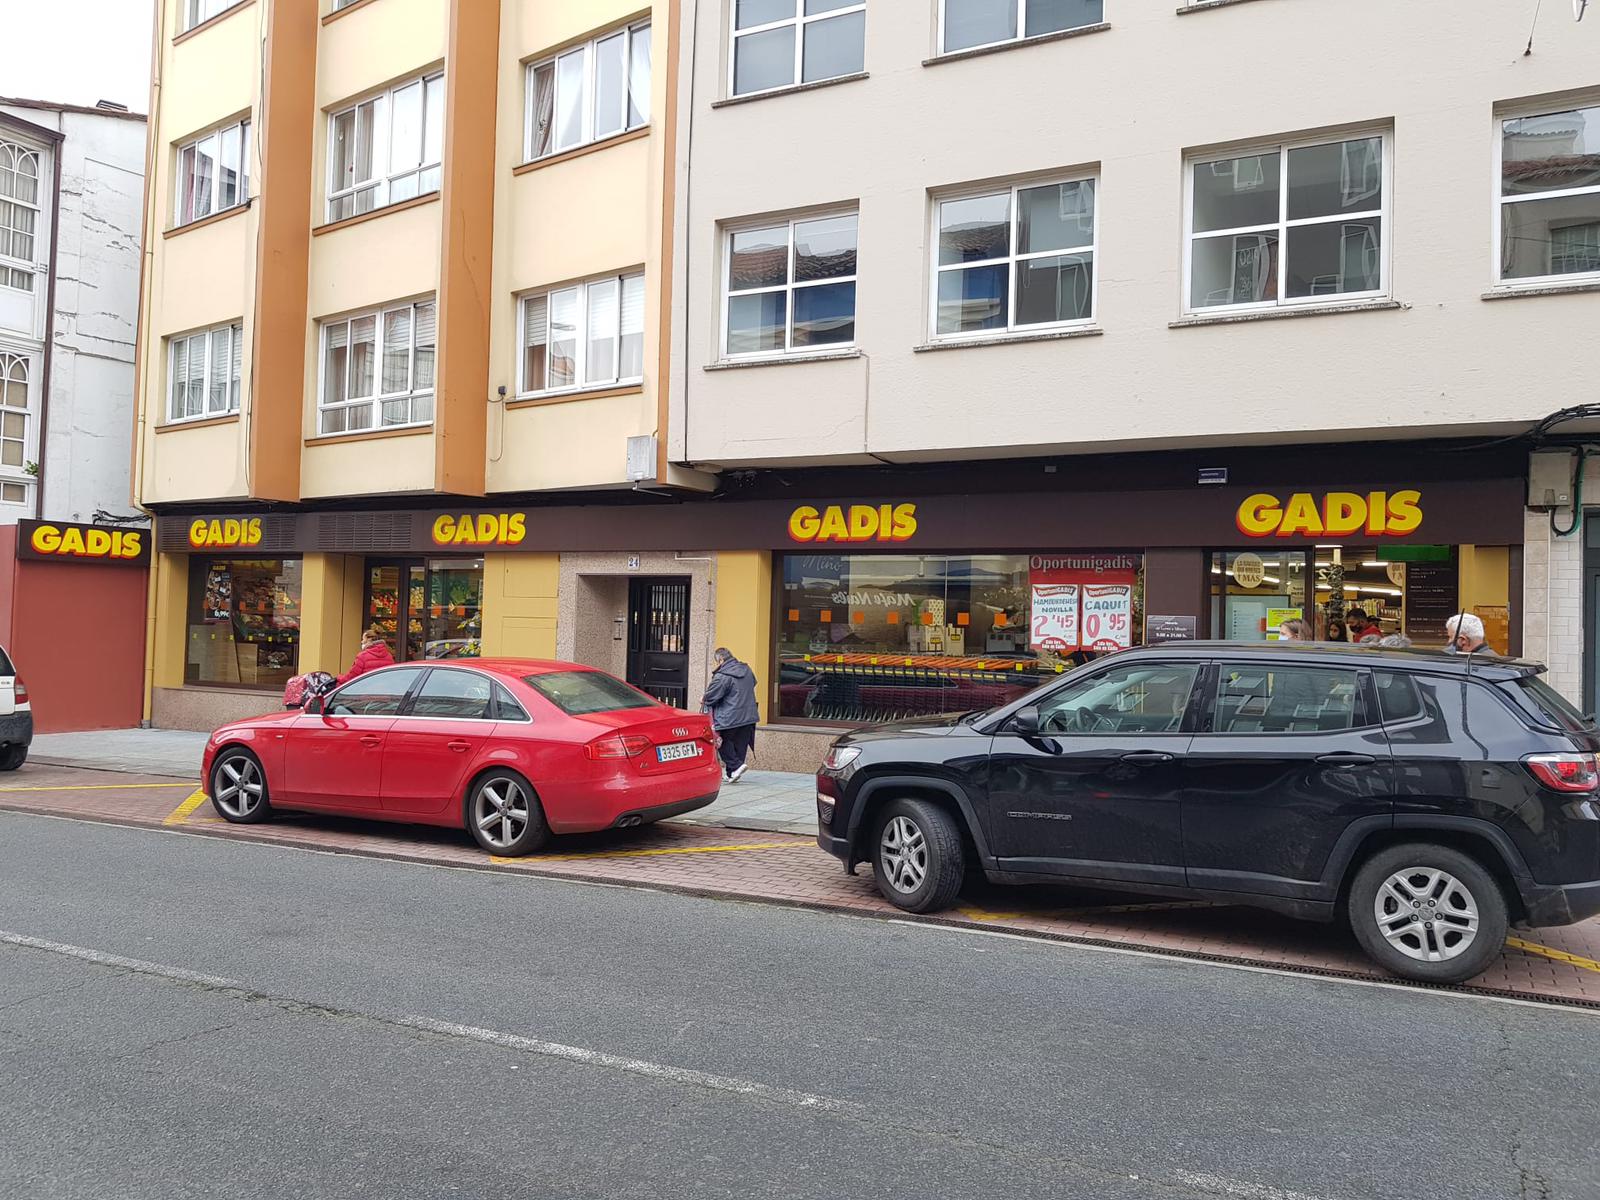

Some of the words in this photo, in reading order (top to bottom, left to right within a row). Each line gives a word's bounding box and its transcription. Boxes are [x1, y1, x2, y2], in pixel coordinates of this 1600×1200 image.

[432, 512, 527, 545] GADIS
[787, 503, 918, 543] GADIS
[1236, 489, 1423, 537] GADIS
[31, 525, 142, 559] GADIS
[189, 517, 262, 547] GADIS
[628, 557, 639, 568] 24
[1030, 555, 1133, 573] Oportunigadis
[662, 745, 681, 760] 3325
